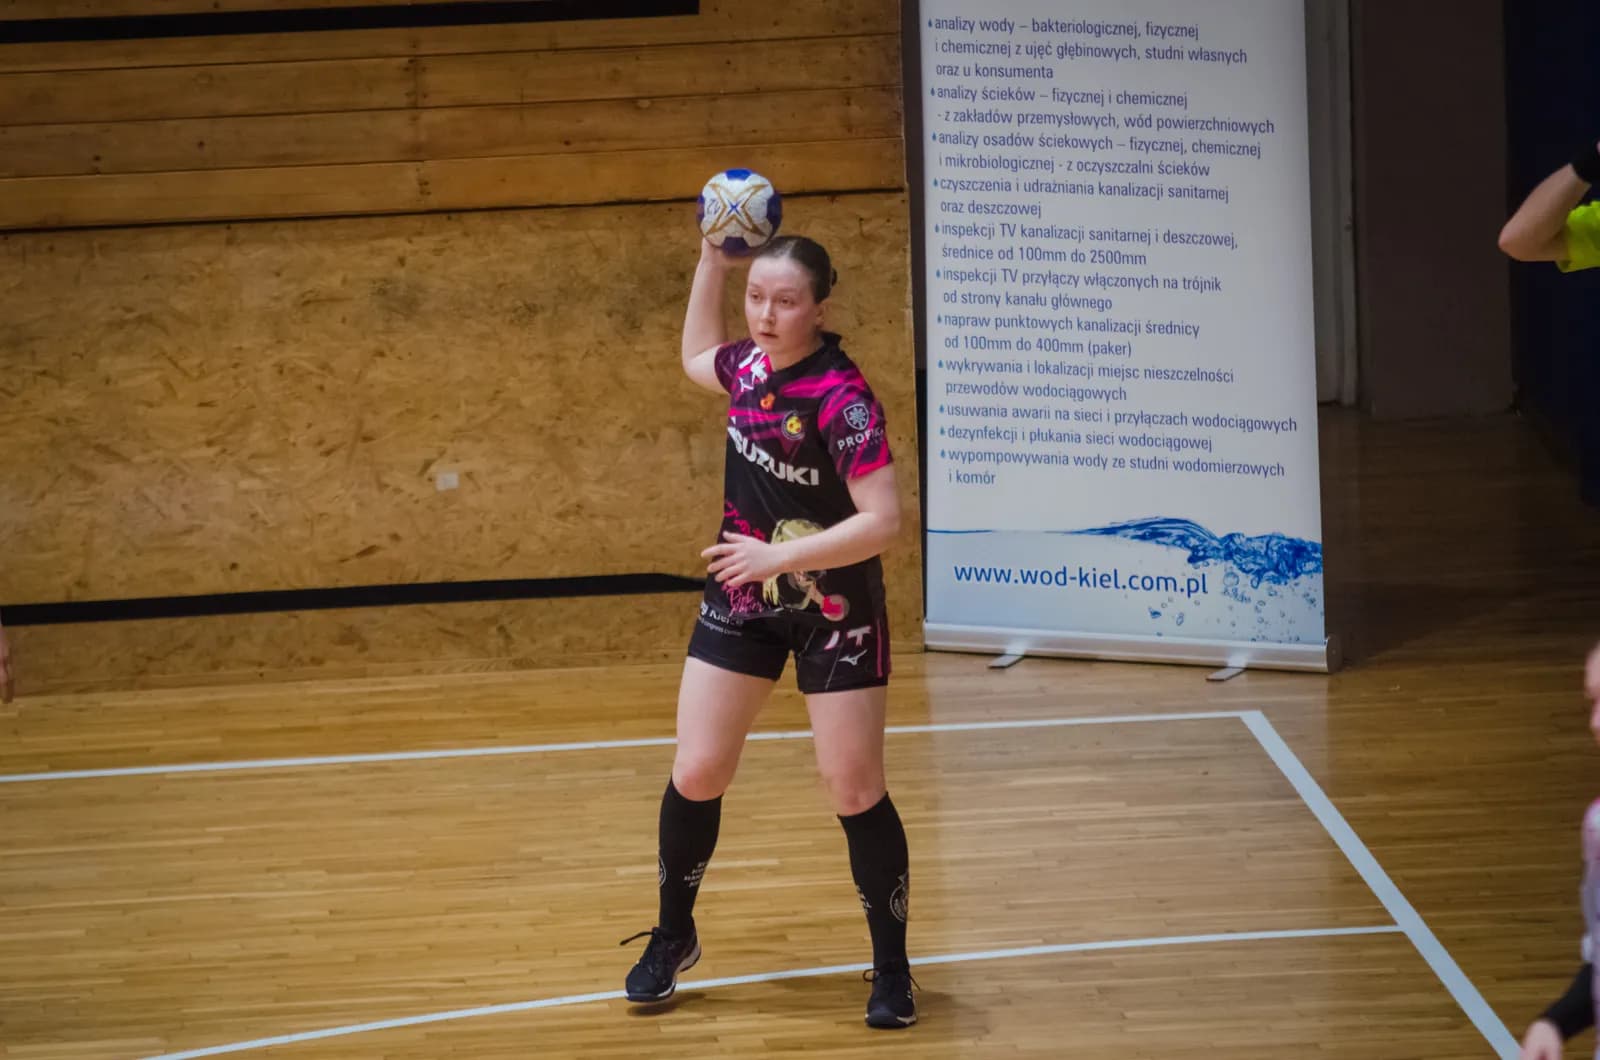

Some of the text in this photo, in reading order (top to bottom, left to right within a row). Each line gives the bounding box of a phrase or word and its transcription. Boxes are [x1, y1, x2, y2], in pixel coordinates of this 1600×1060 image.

[934, 15, 976, 35] analizy
[978, 17, 1016, 35] wody
[1031, 17, 1141, 40] bakteriologicznej,
[1145, 21, 1199, 41] fizycznej
[934, 38, 1248, 65] i chemicznej z ujęć głębinowych, studni własnych
[936, 62, 1054, 79] oraz u konsumenta
[936, 85, 978, 103] analizy
[981, 86, 1036, 101] ścieków
[1052, 87, 1105, 108] fizycznej
[1108, 90, 1112, 104] i
[1116, 90, 1188, 110] chemicznej
[944, 111, 950, 122] z
[953, 108, 1013, 124] zakładów
[1016, 111, 1120, 130] przemysłowych,
[1123, 113, 1153, 128] wód
[1156, 116, 1275, 136] powierzchniowych
[938, 131, 980, 149] analizy
[982, 132, 1035, 147] osadów
[1038, 132, 1113, 152] ściekowych
[1129, 136, 1188, 156] fizycznej,
[1191, 138, 1261, 160] chemicznej
[938, 151, 943, 168] i
[944, 153, 1055, 174] mikrobiologicznej
[1066, 160, 1073, 171] z
[1076, 159, 1154, 176] oczyszczalni
[1157, 160, 1210, 176] ścieków
[939, 177, 1229, 204] czyszczenia i udrażniania kanalizacji sanitarnej
[940, 199, 1042, 219] oraz deszczowej
[941, 222, 1238, 250] inspekcji TV kanalizacji sanitarnej i deszczowej,
[942, 244, 1147, 265] średnice od 100mm do 2500mm
[942, 267, 1222, 294] inspekcji TV przyłączy włączonych na trójnik
[943, 289, 1113, 313] od strony kanału głównego
[944, 314, 1200, 339] napraw punktowych kanalizacji średnicy
[944, 335, 1132, 358] od 100mm do 400mm (paker)
[945, 357, 1234, 384] wykrywania i lokalizacji miejsc nieszczelności
[945, 381, 1127, 403] przewodów wodociągowych
[946, 405, 1298, 435] usuwania awarii na sieci i przyłączach wodociągowych
[947, 424, 1212, 453] dezynfekcji i płukania sieci wodociągowej
[727, 426, 820, 486] SUZUKI
[948, 450, 1285, 479] wypompowywania wody ze studni wodomierzowych
[948, 469, 996, 485] i komór
[954, 566, 1208, 598] www.wod-kiel.com.pl
